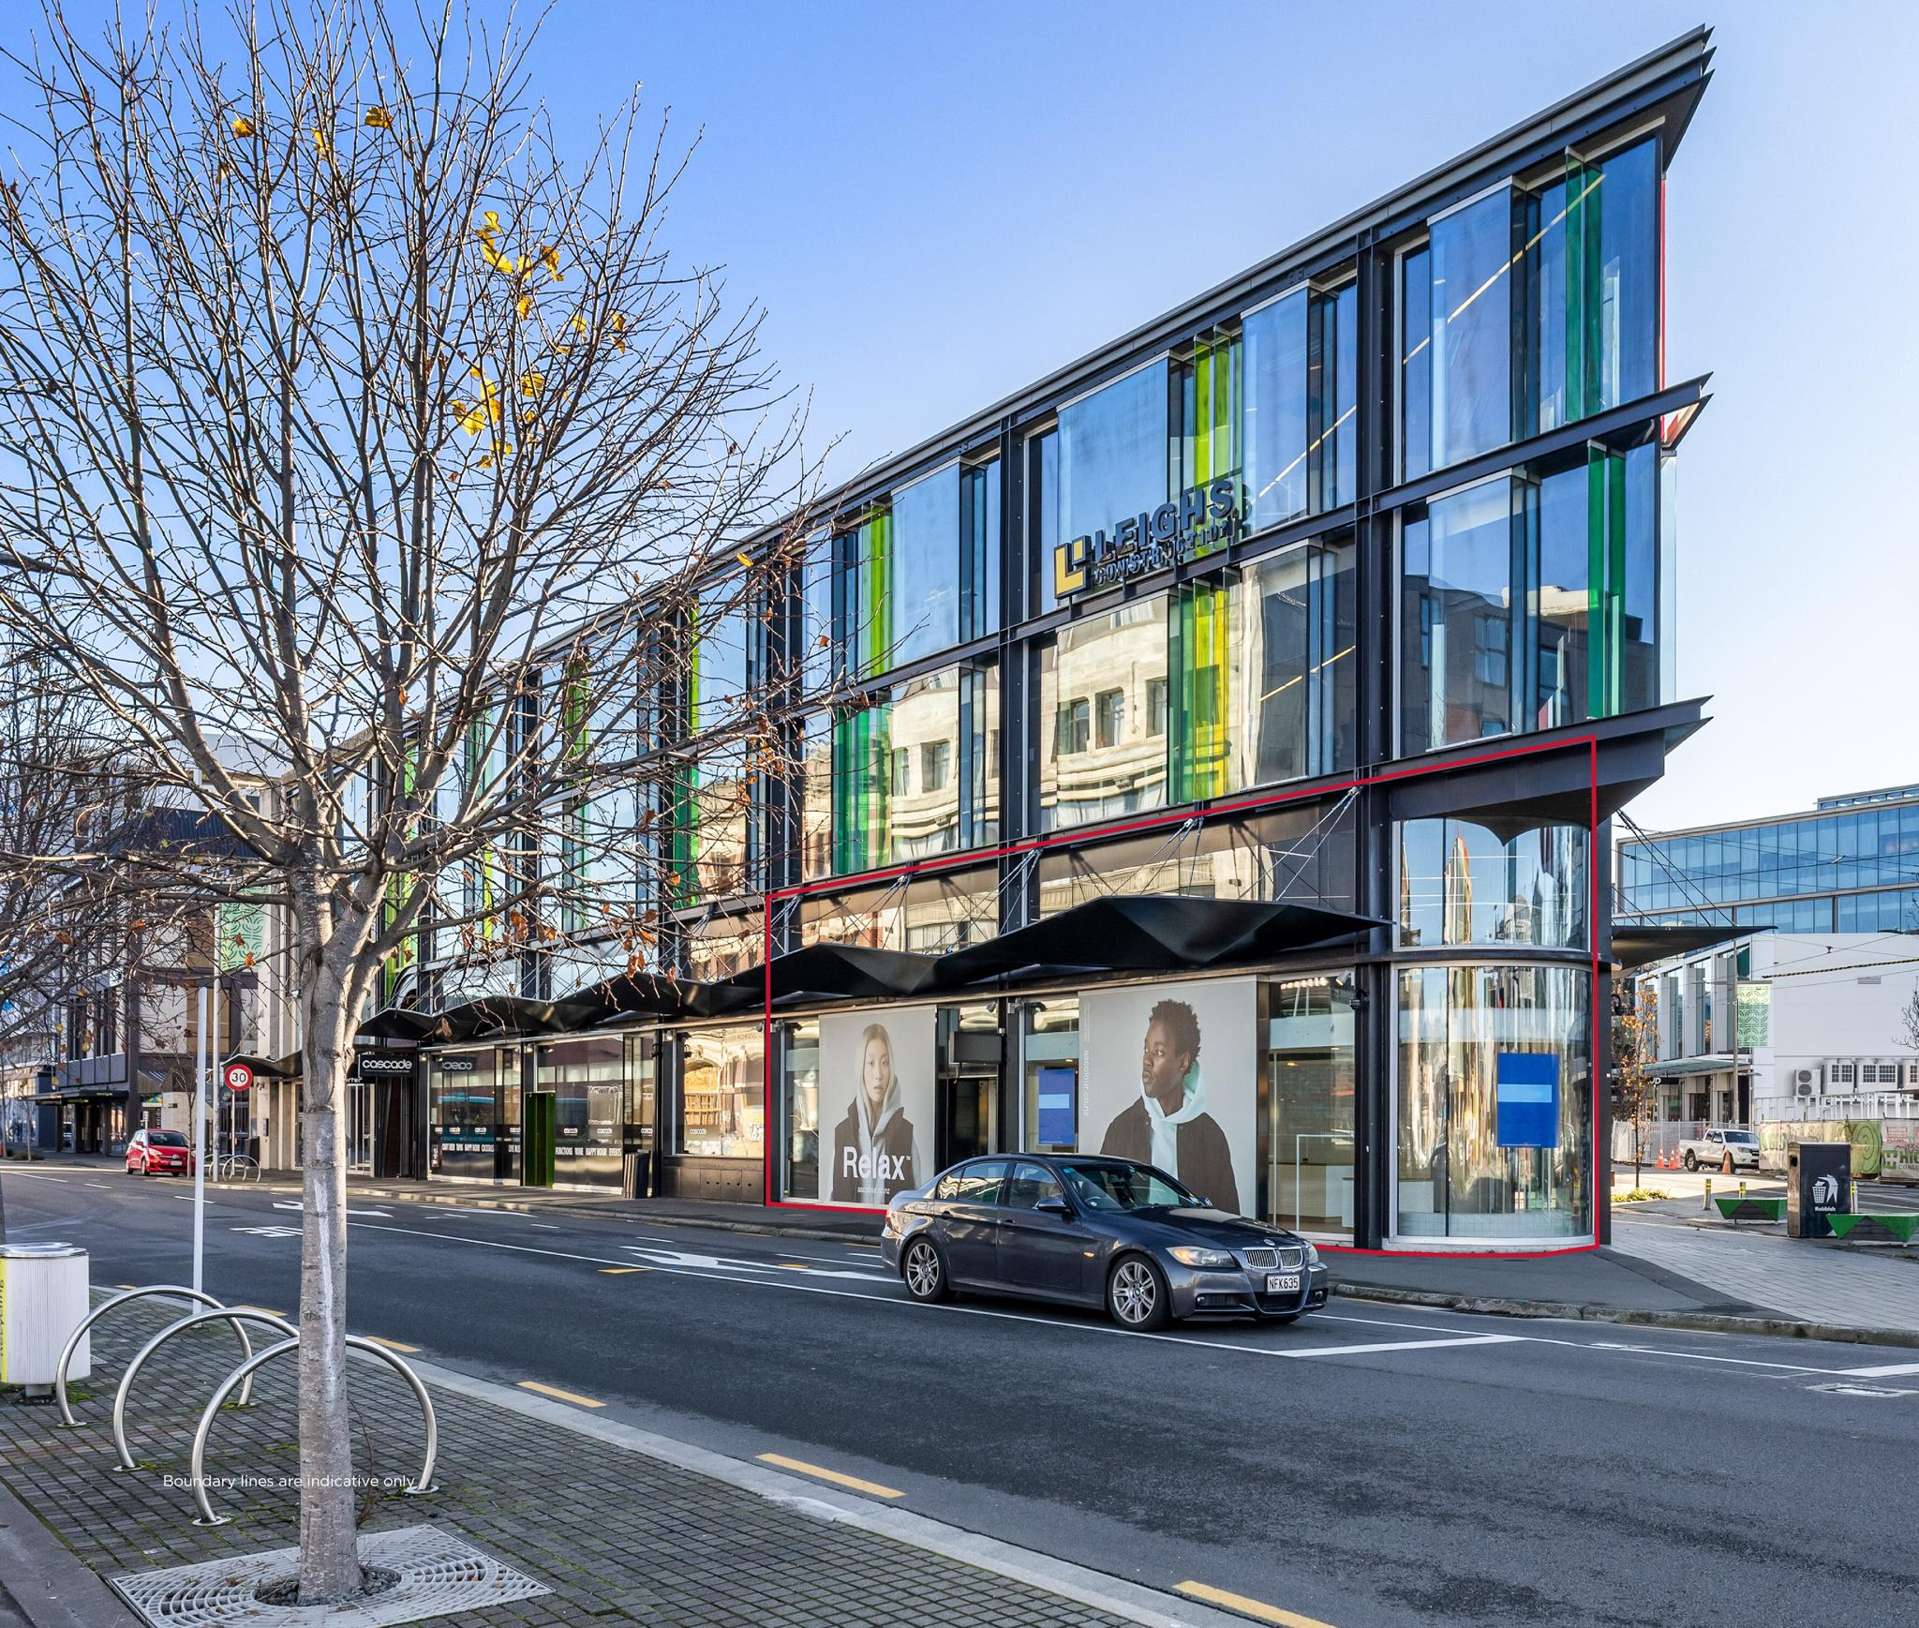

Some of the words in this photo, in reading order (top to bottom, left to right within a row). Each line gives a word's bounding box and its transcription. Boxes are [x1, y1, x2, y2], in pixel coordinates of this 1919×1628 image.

[1095, 480, 1235, 564] LEIGHS
[362, 1059, 412, 1070] cascade
[232, 1072, 246, 1083] 30
[1269, 1277, 1299, 1290] NFK635
